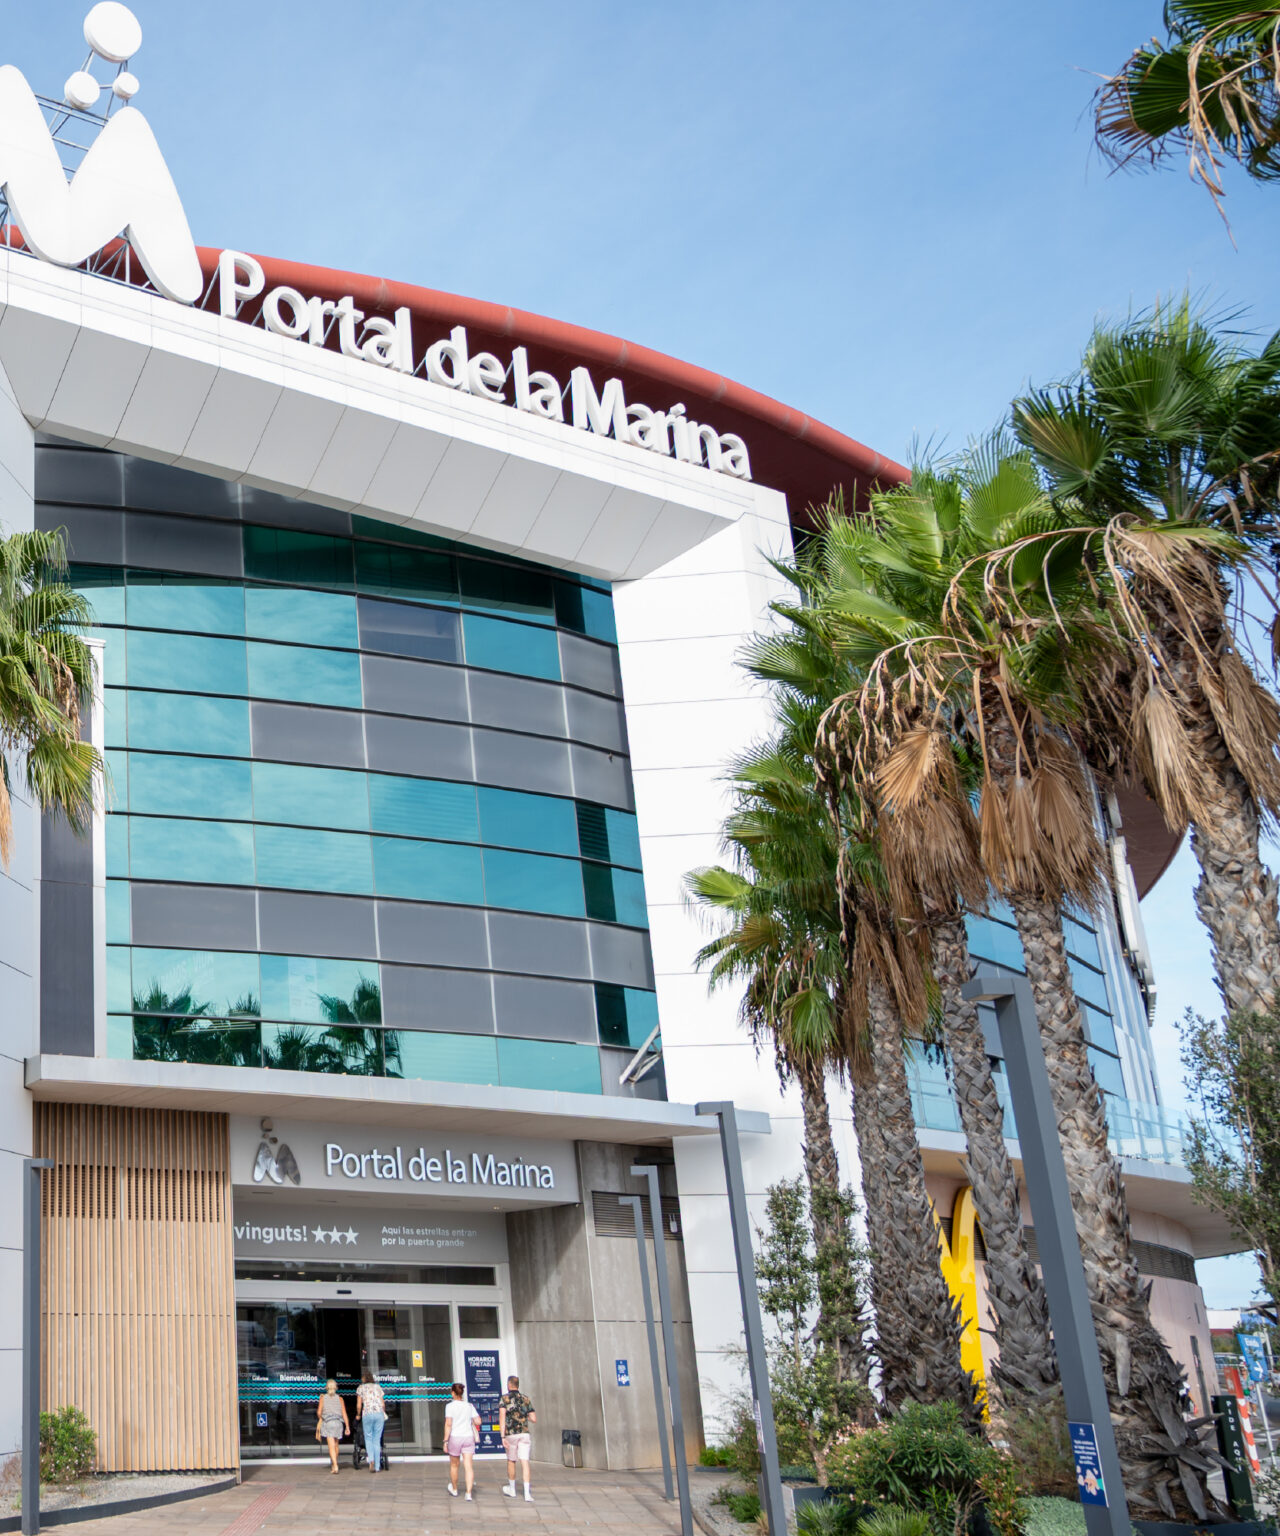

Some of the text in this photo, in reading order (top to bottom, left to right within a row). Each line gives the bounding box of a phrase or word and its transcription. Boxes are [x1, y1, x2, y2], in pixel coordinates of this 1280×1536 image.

[219, 248, 753, 481] Portal de la Marina
[325, 1143, 554, 1188] Portal de la Marina
[234, 1221, 308, 1244] vinguts!
[381, 1236, 465, 1248] por la puerta grande
[402, 1226, 414, 1235] las
[416, 1226, 450, 1237] estrellas
[451, 1229, 477, 1237] entran
[279, 1374, 318, 1382] Bienvenidos
[1226, 1400, 1236, 1431] PIDE
